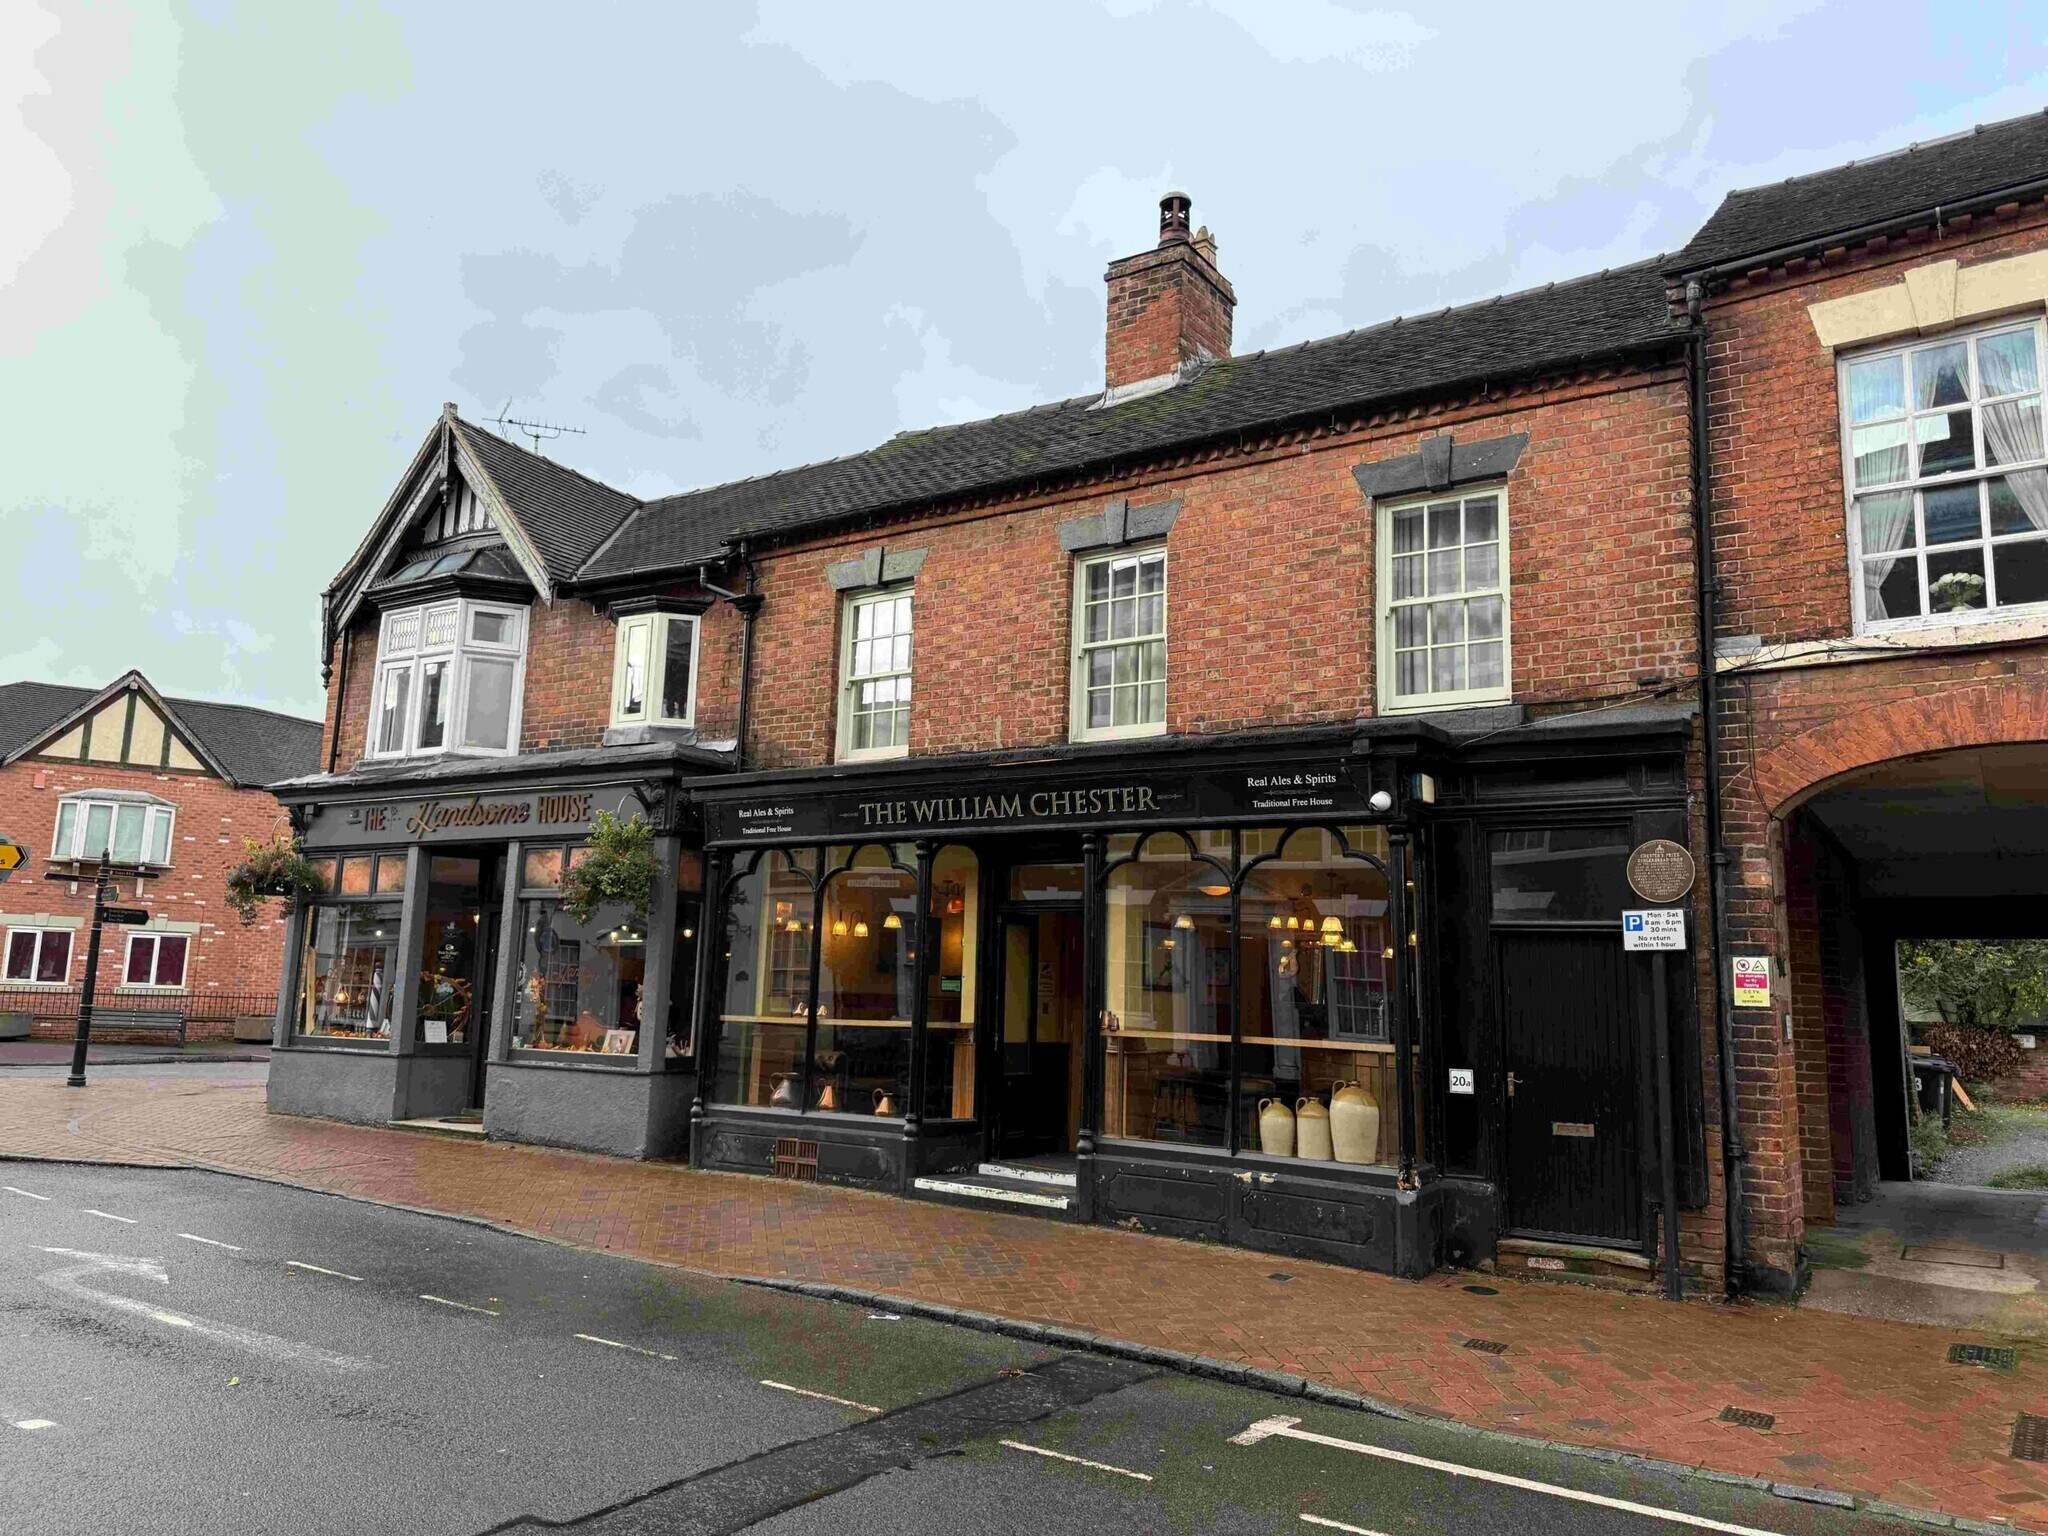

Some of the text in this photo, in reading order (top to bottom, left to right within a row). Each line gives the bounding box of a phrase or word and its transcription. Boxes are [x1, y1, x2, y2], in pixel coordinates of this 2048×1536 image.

[1246, 772, 1336, 788] Real Ales & Spirits
[859, 786, 1160, 826] THE WILLIAM CHESTER
[1252, 797, 1333, 809] Traditional Free House
[364, 793, 593, 839] THE Handsome HOUSE
[738, 806, 794, 818] Real Ales & Spirits
[742, 825, 792, 835] Traditional Free House
[1629, 916, 1641, 931] P
[1671, 919, 1682, 927] pm
[1452, 1076, 1471, 1087] 20a
